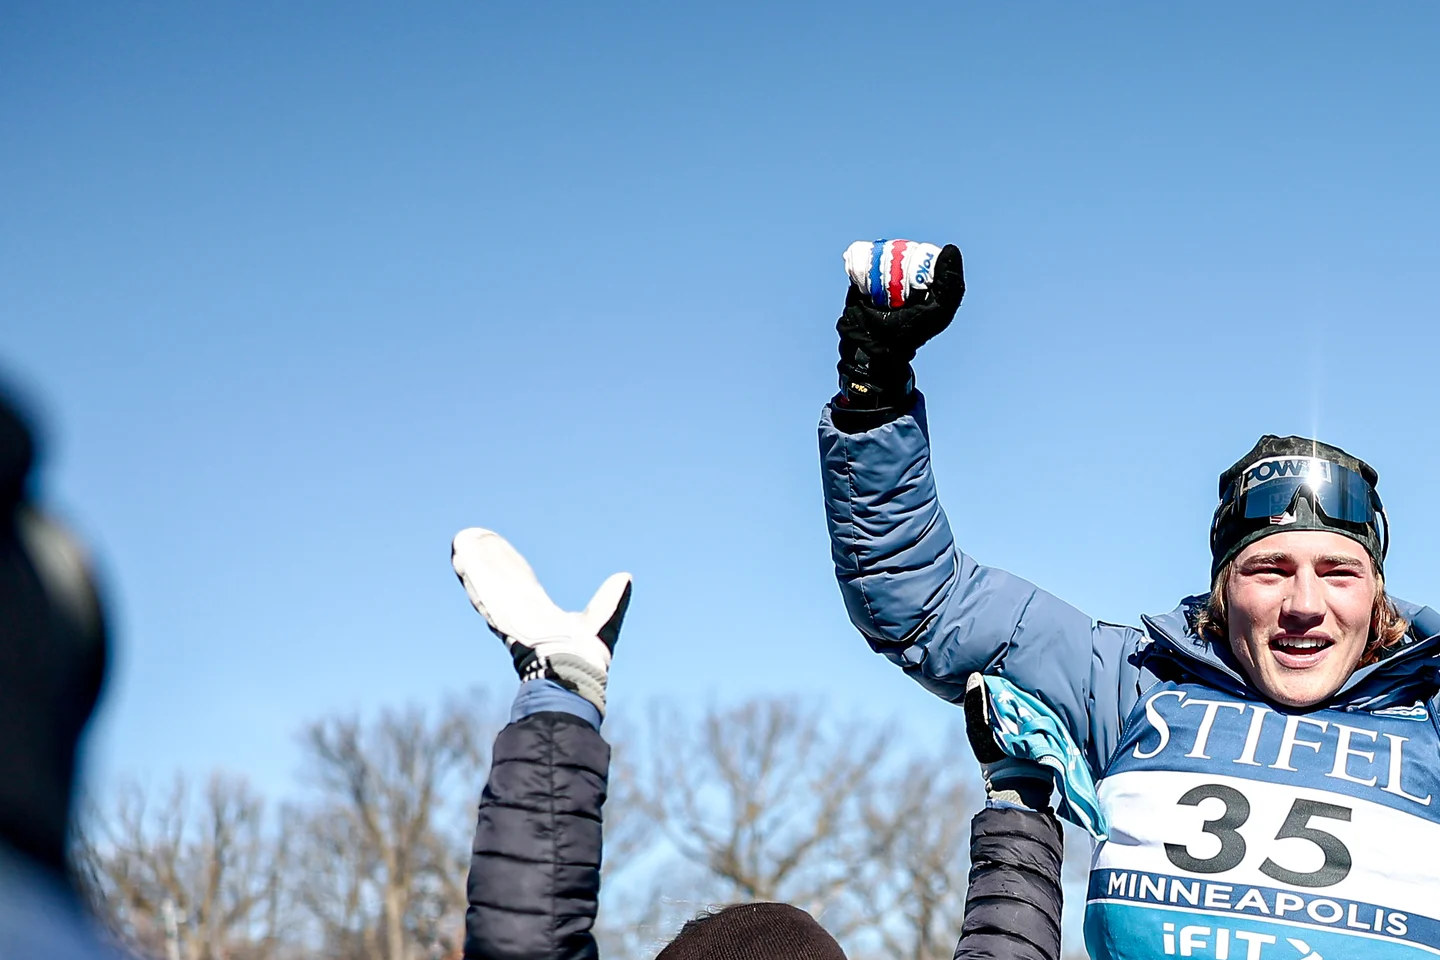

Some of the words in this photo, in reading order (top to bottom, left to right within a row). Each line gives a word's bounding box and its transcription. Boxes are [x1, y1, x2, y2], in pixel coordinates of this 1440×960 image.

[1132, 690, 1431, 806] STIFEL
[1163, 783, 1353, 888] 35
[1107, 871, 1409, 937] MINNEAPOLIS
